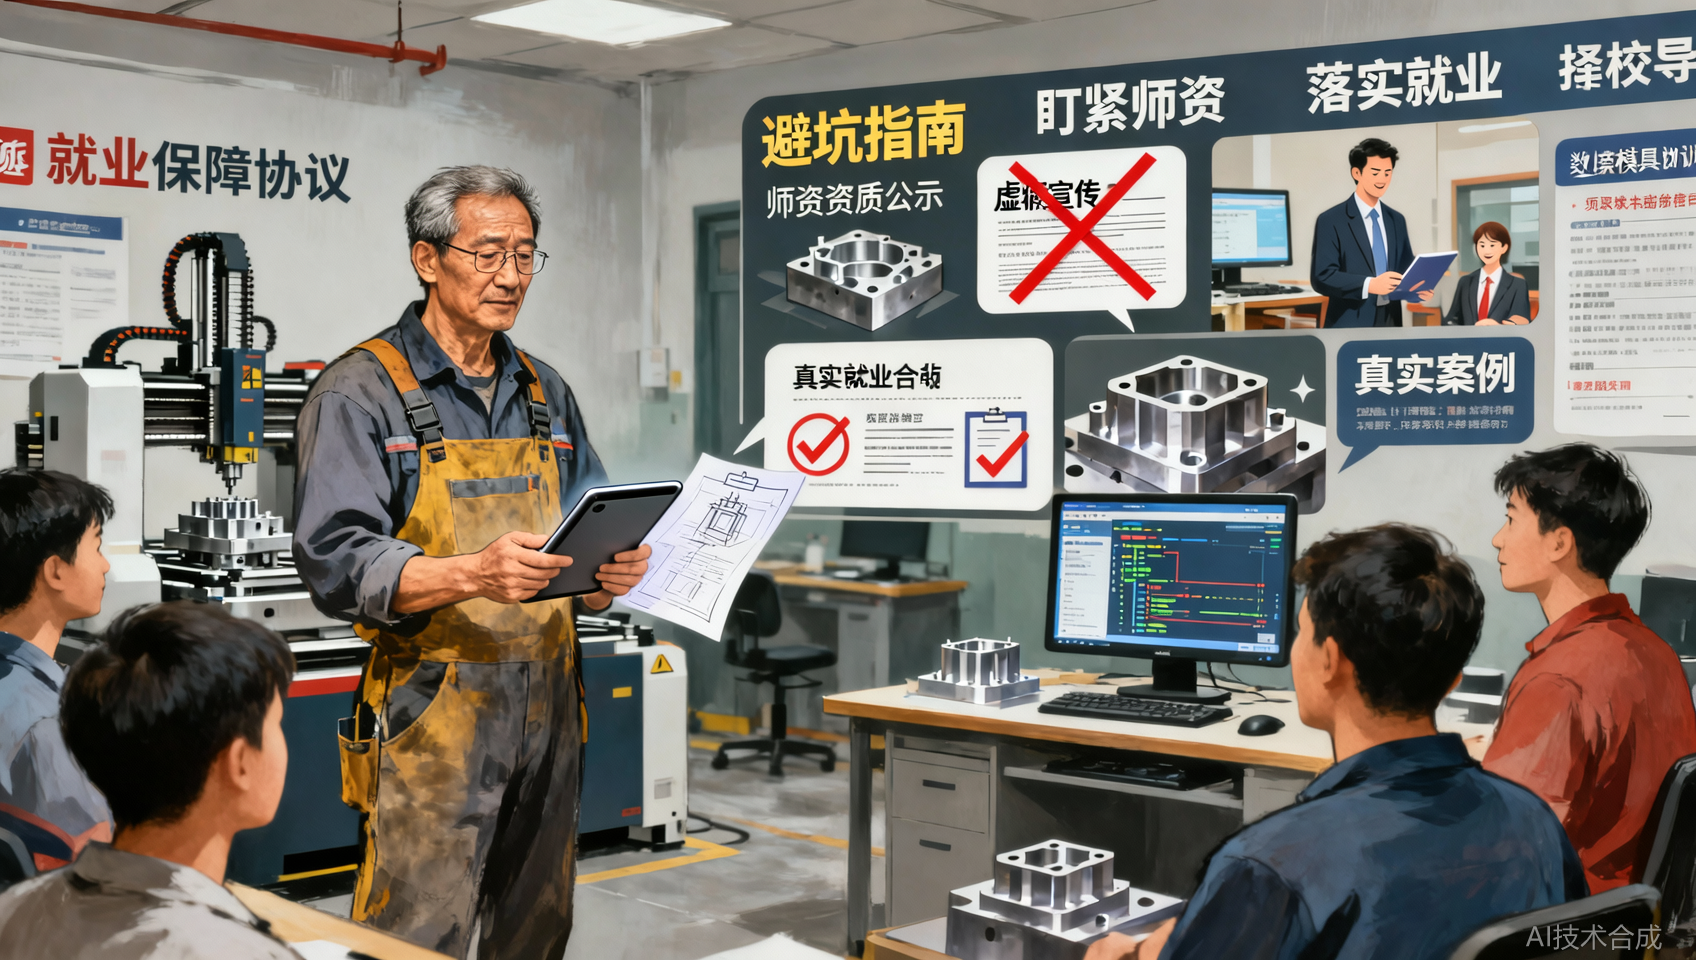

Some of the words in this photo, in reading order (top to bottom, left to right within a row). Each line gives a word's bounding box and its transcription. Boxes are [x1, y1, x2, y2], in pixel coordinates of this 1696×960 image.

[1037, 75, 1225, 136] 盯紧师资
[1306, 50, 1503, 115] 落实就业
[46, 132, 353, 204] 就业保障协议
[761, 99, 967, 168] 避坑指南
[766, 180, 944, 219] 师资资质公示
[1354, 351, 1516, 396] 真实案例
